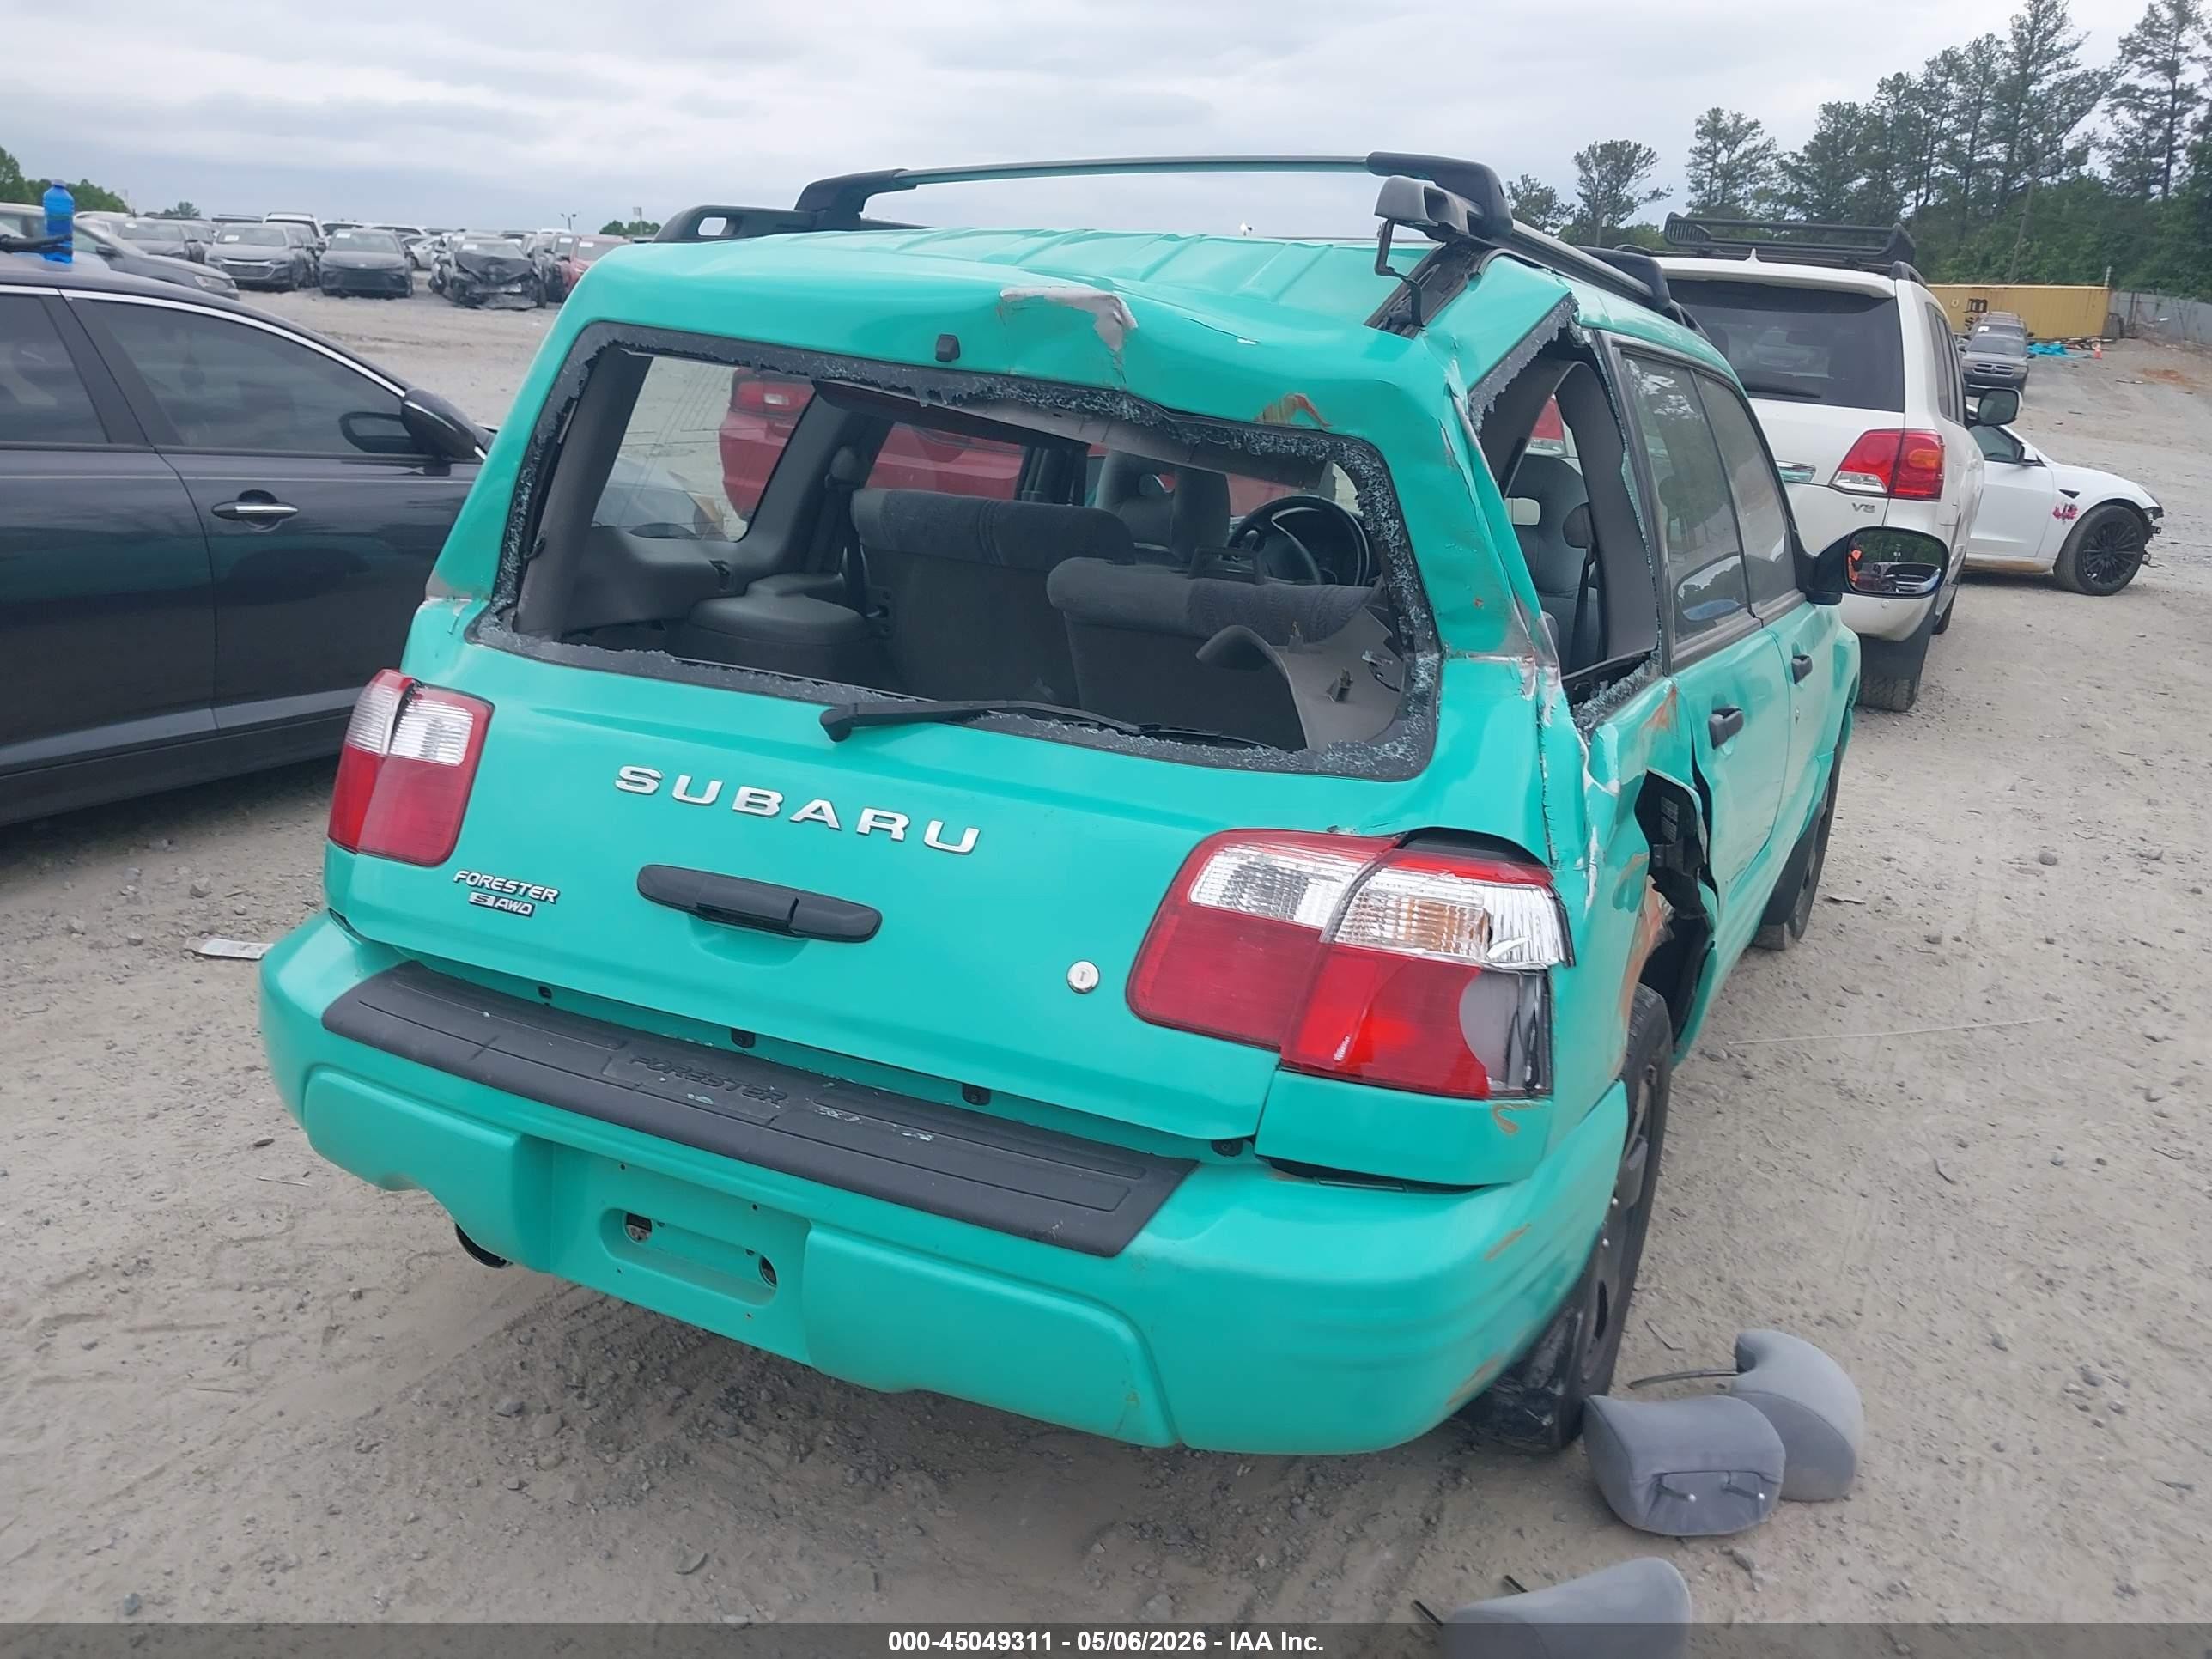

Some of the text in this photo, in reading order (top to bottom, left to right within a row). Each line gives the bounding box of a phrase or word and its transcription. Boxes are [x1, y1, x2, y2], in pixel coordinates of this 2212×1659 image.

[1851, 502, 1876, 514] V8
[614, 765, 981, 855] SUBARU
[453, 870, 560, 904] FORESTER
[495, 898, 534, 916] AWD
[629, 1055, 788, 1106] FORESTER
